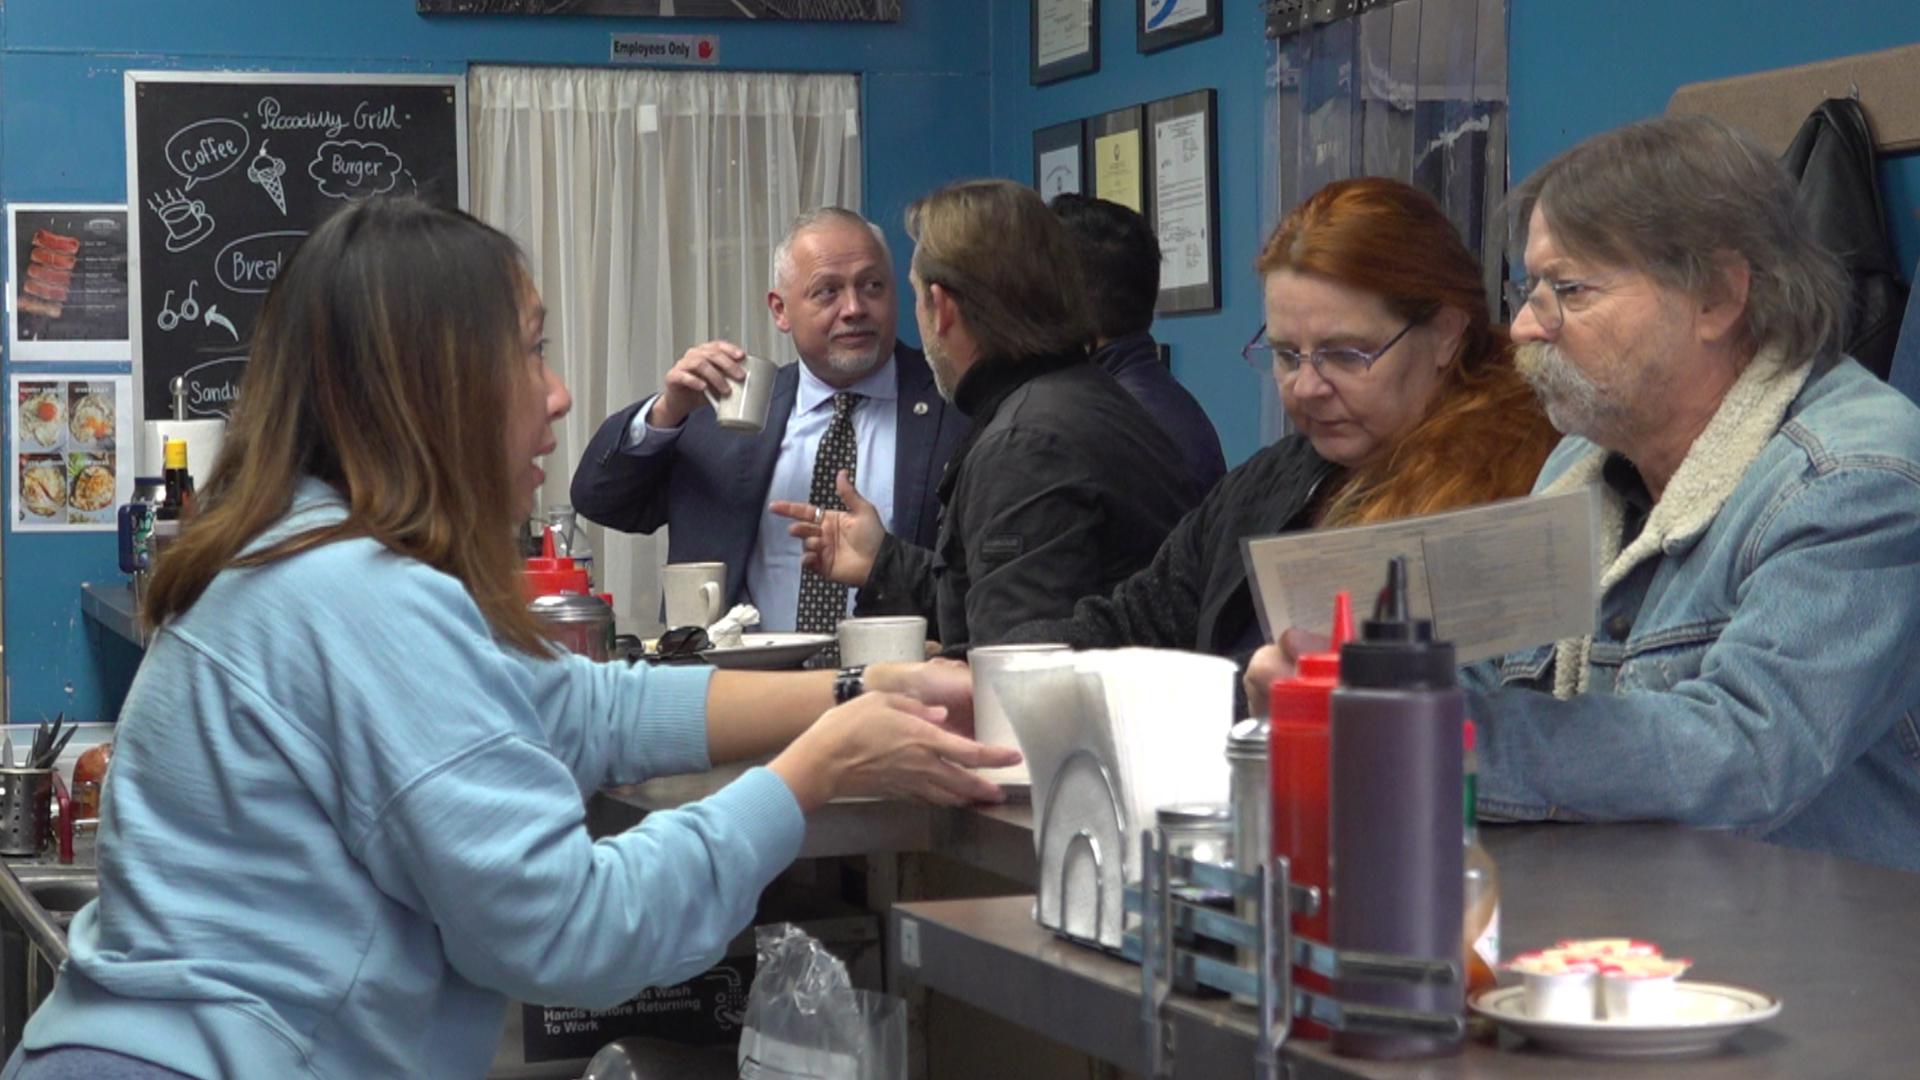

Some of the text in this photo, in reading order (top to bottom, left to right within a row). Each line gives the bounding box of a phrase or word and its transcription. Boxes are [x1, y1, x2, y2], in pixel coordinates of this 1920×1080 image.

[613, 40, 690, 59] Employees Only
[354, 101, 402, 130] Grill
[181, 136, 238, 173] Coffee
[331, 153, 384, 187] Burger
[655, 985, 691, 998] Wash
[543, 1008, 587, 1022] Hands
[636, 998, 701, 1014] Returning
[544, 1019, 599, 1035] To Work
